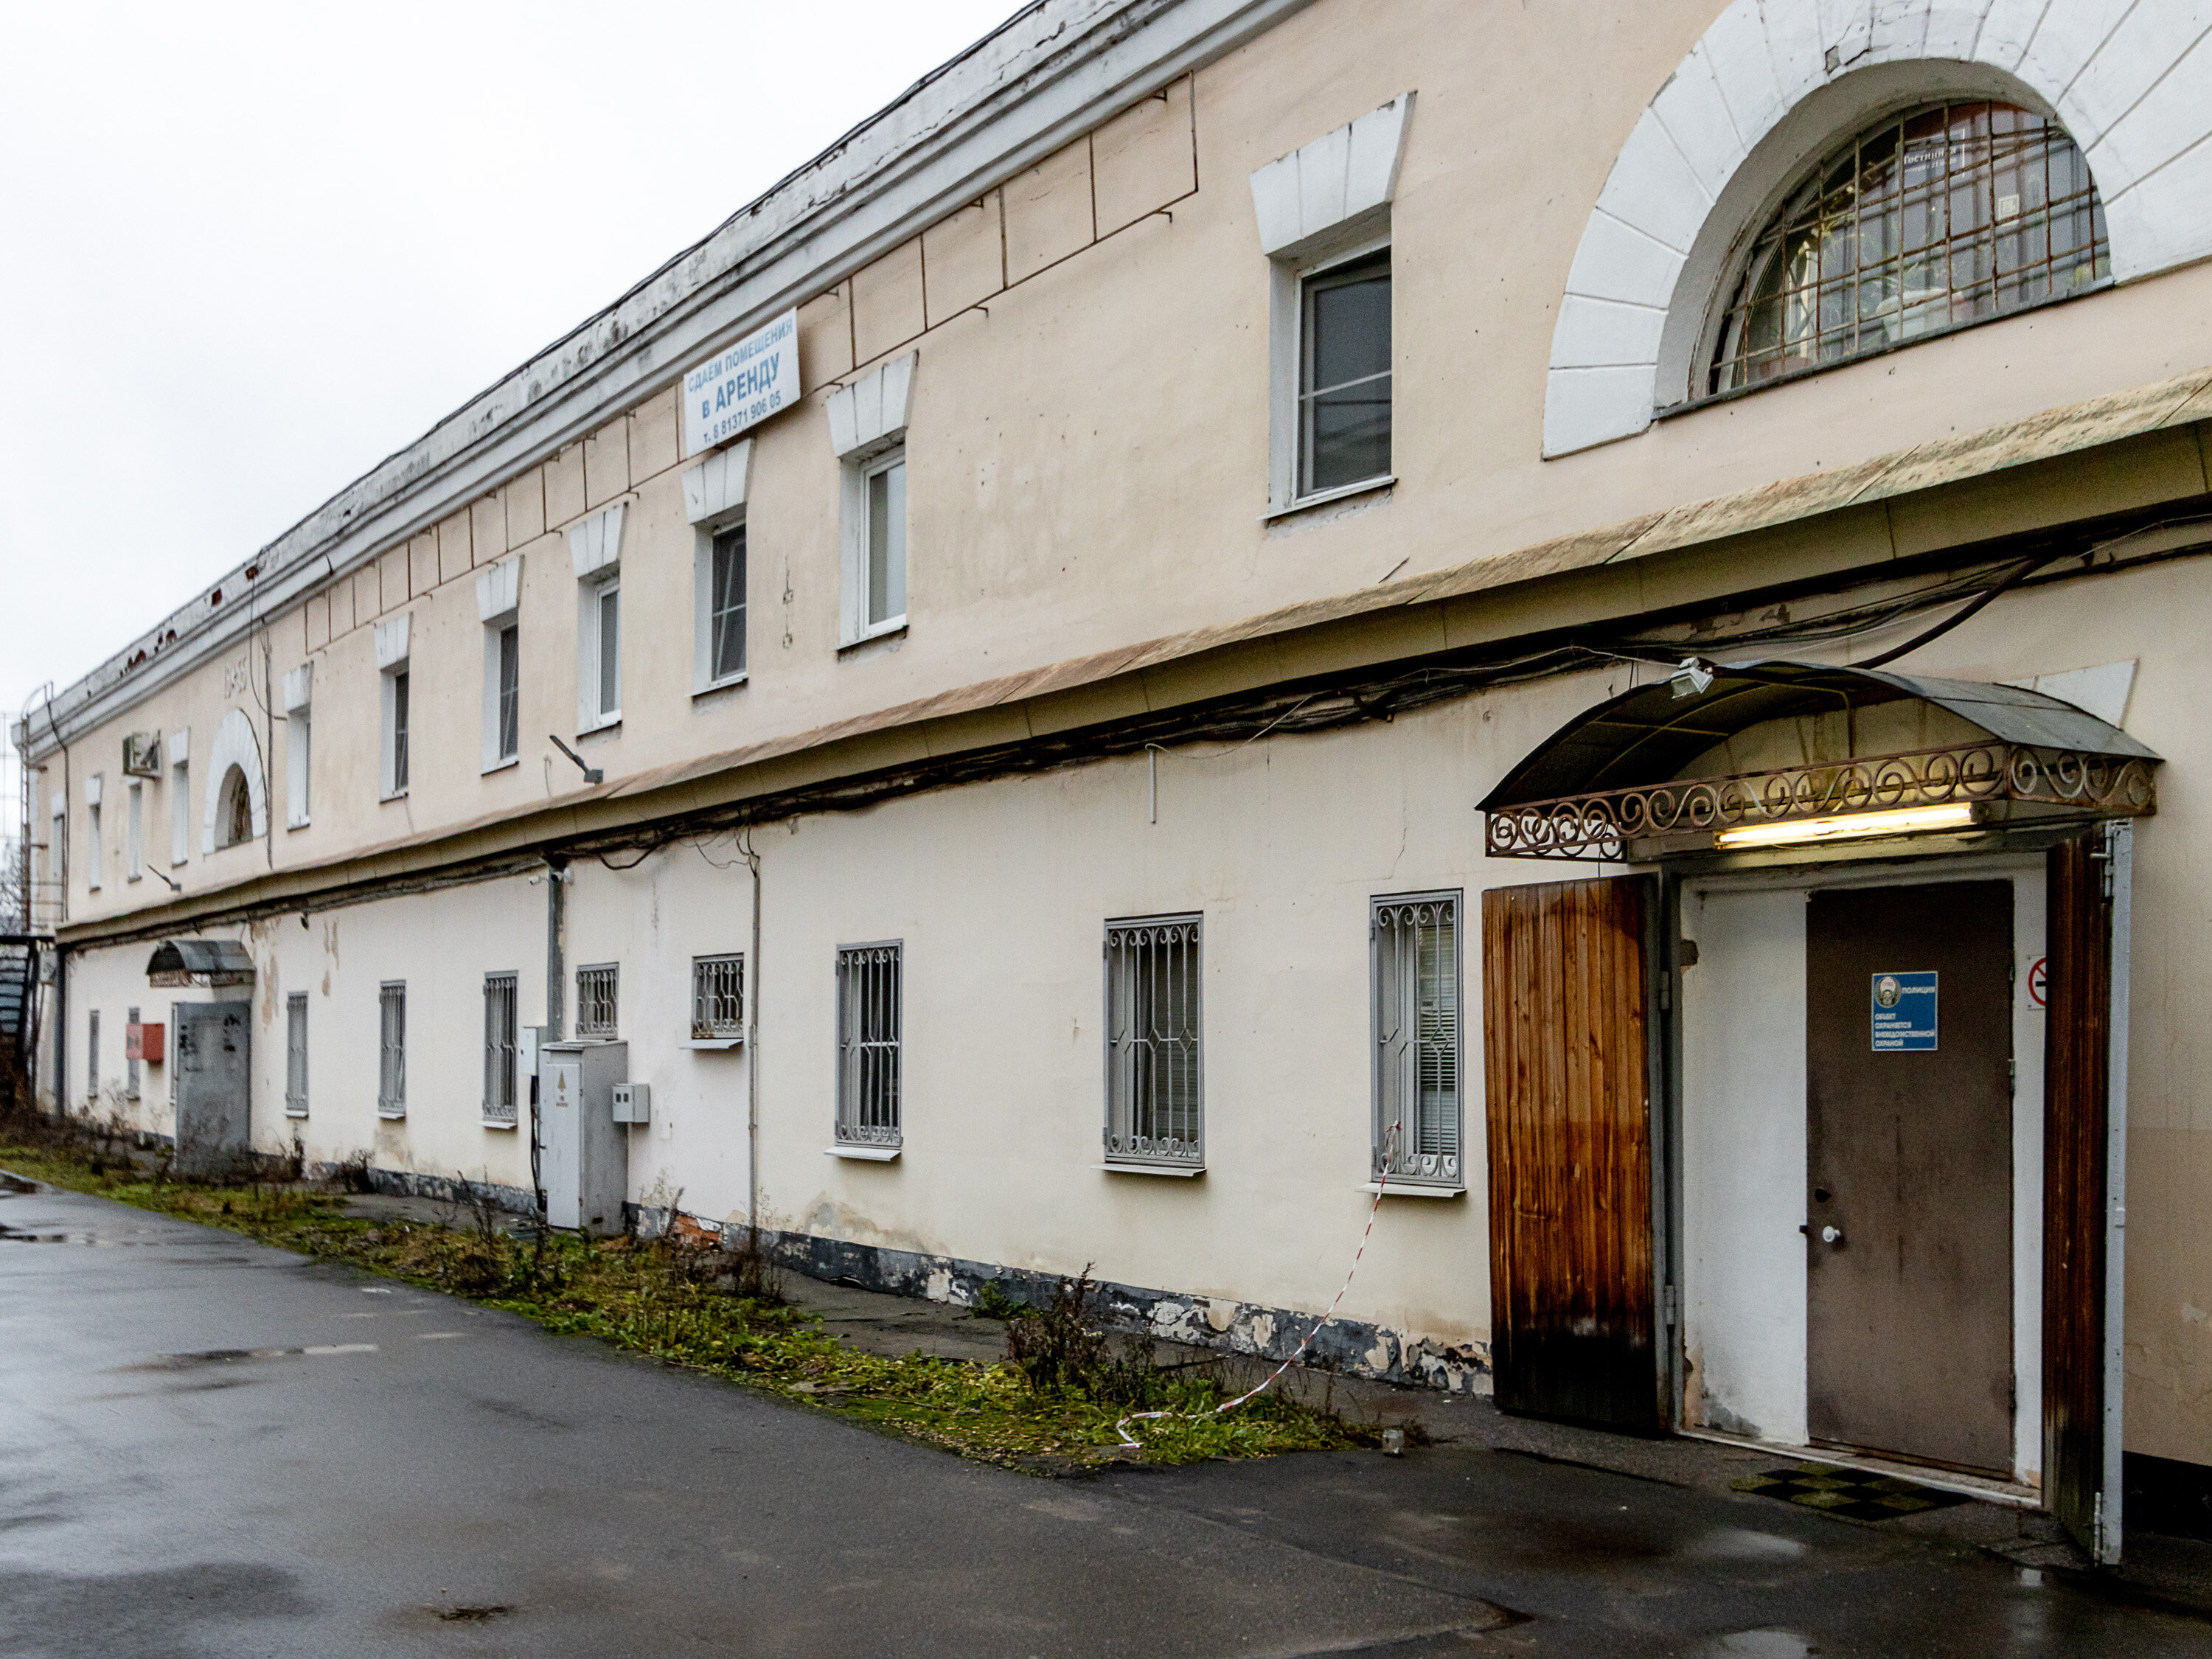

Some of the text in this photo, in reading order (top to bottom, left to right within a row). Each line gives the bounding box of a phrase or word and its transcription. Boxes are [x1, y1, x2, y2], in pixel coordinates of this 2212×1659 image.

[1904, 147, 1956, 165] Гостиниа
[726, 318, 793, 372] ПОМЕЩЕНИЯ
[702, 352, 779, 420] В АРЕНДУ
[713, 424, 719, 439] 8
[721, 408, 748, 435] 81371
[751, 398, 768, 420] 906
[769, 390, 782, 407] 05
[1902, 987, 1935, 995] ПОЛИЦИЯ
[1875, 1029, 1935, 1038] ВНЕВЕДОМСТВЕННОЙ
[1875, 1038, 1904, 1047] ОХРАНОЙ
